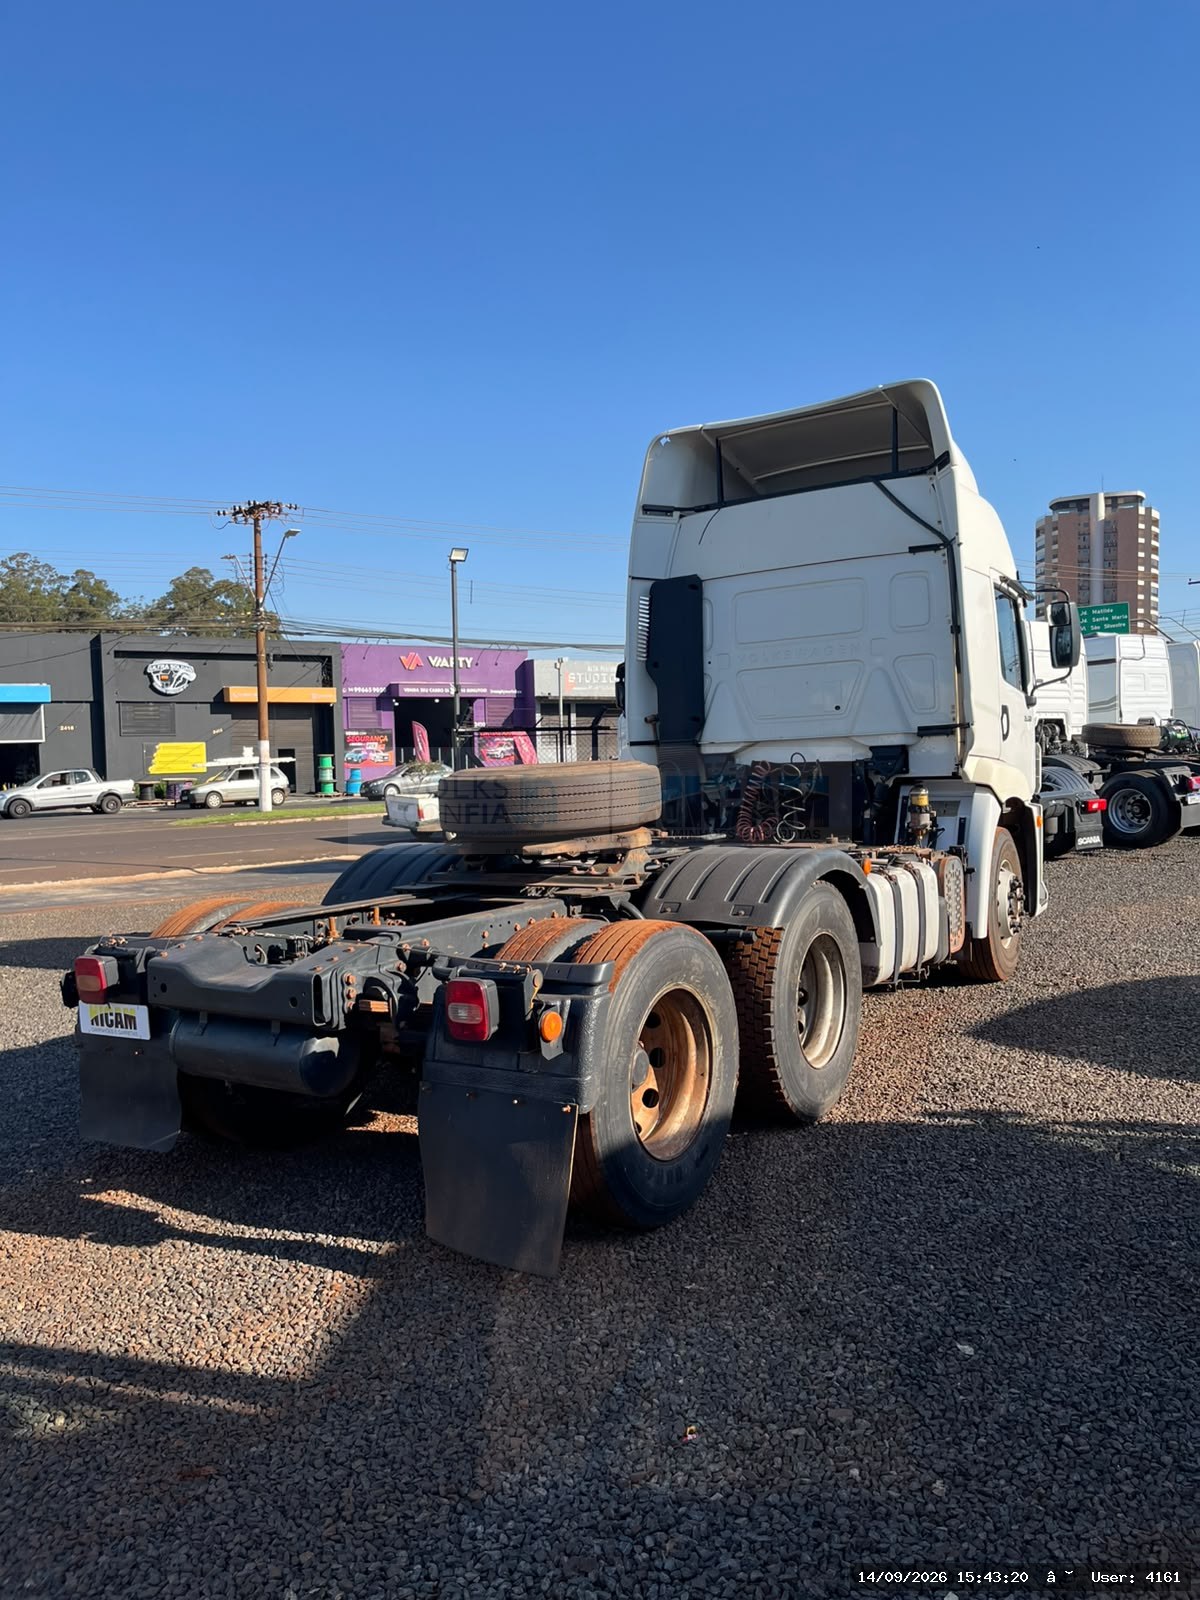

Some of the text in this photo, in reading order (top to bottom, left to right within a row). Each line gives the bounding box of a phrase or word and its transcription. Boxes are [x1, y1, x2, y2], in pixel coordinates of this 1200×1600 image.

[346, 735, 389, 743] SEGURANÇA
[1077, 835, 1101, 846] SCANIA
[89, 1003, 137, 1031] NICAM
